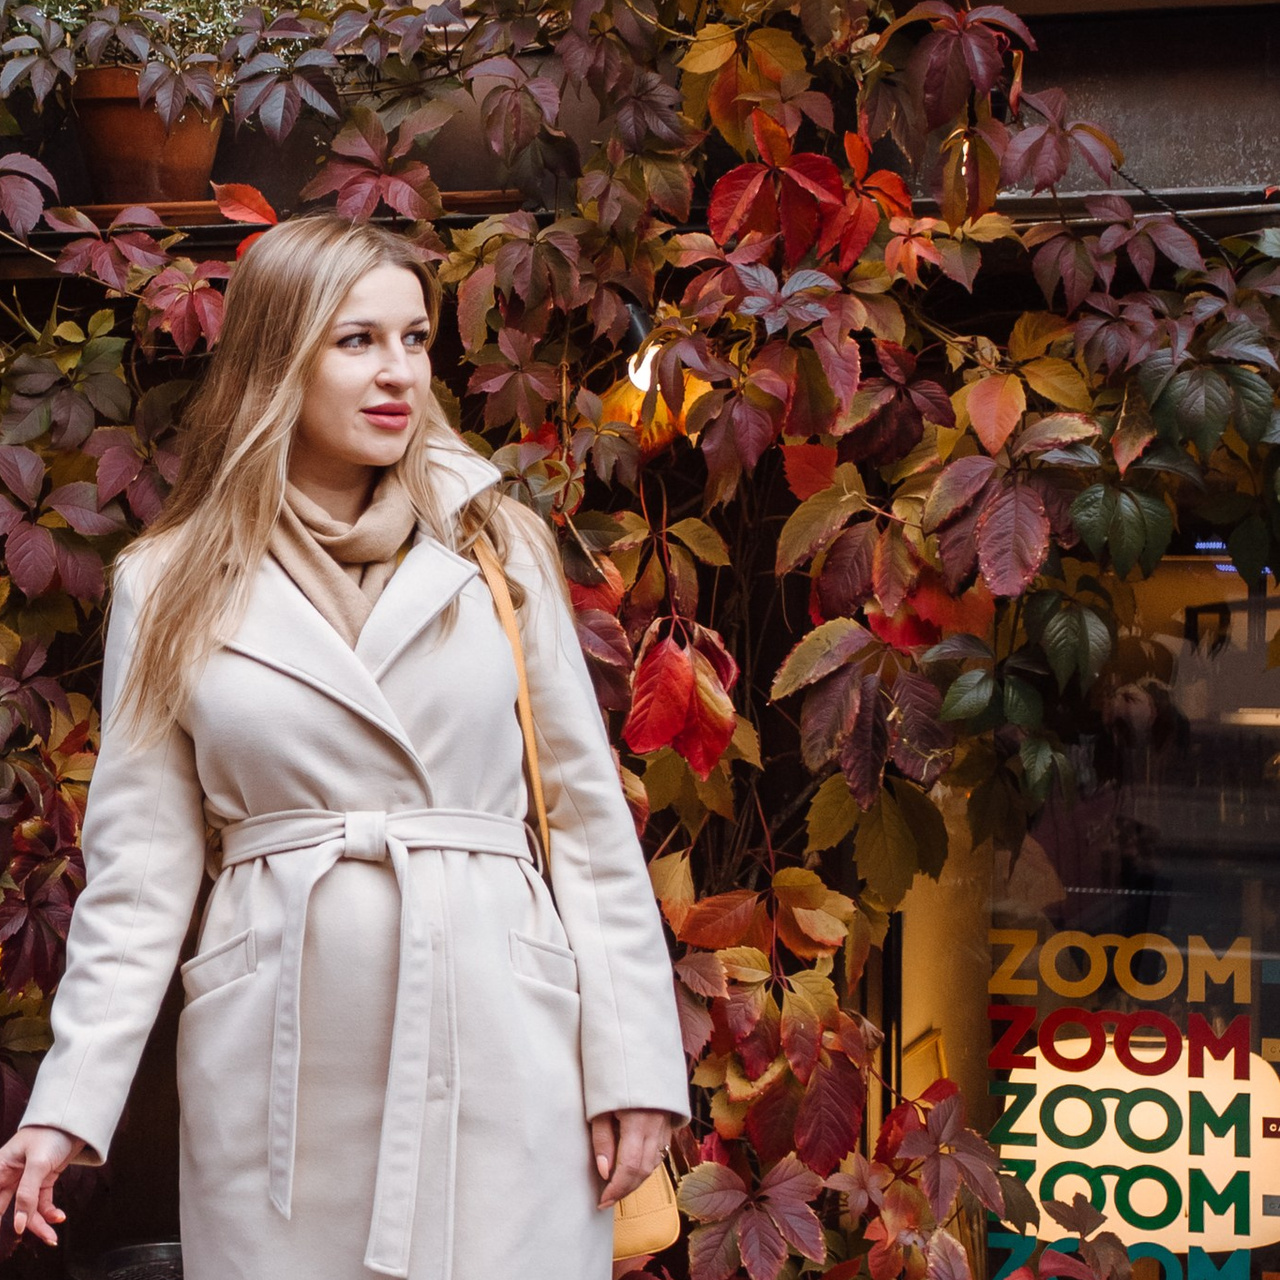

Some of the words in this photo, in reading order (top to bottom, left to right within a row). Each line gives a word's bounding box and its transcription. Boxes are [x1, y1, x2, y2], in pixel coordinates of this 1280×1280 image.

[987, 929, 1252, 1004] ZOOM
[987, 1005, 1251, 1081] ZOOM
[987, 1081, 1252, 1158] ZOOM
